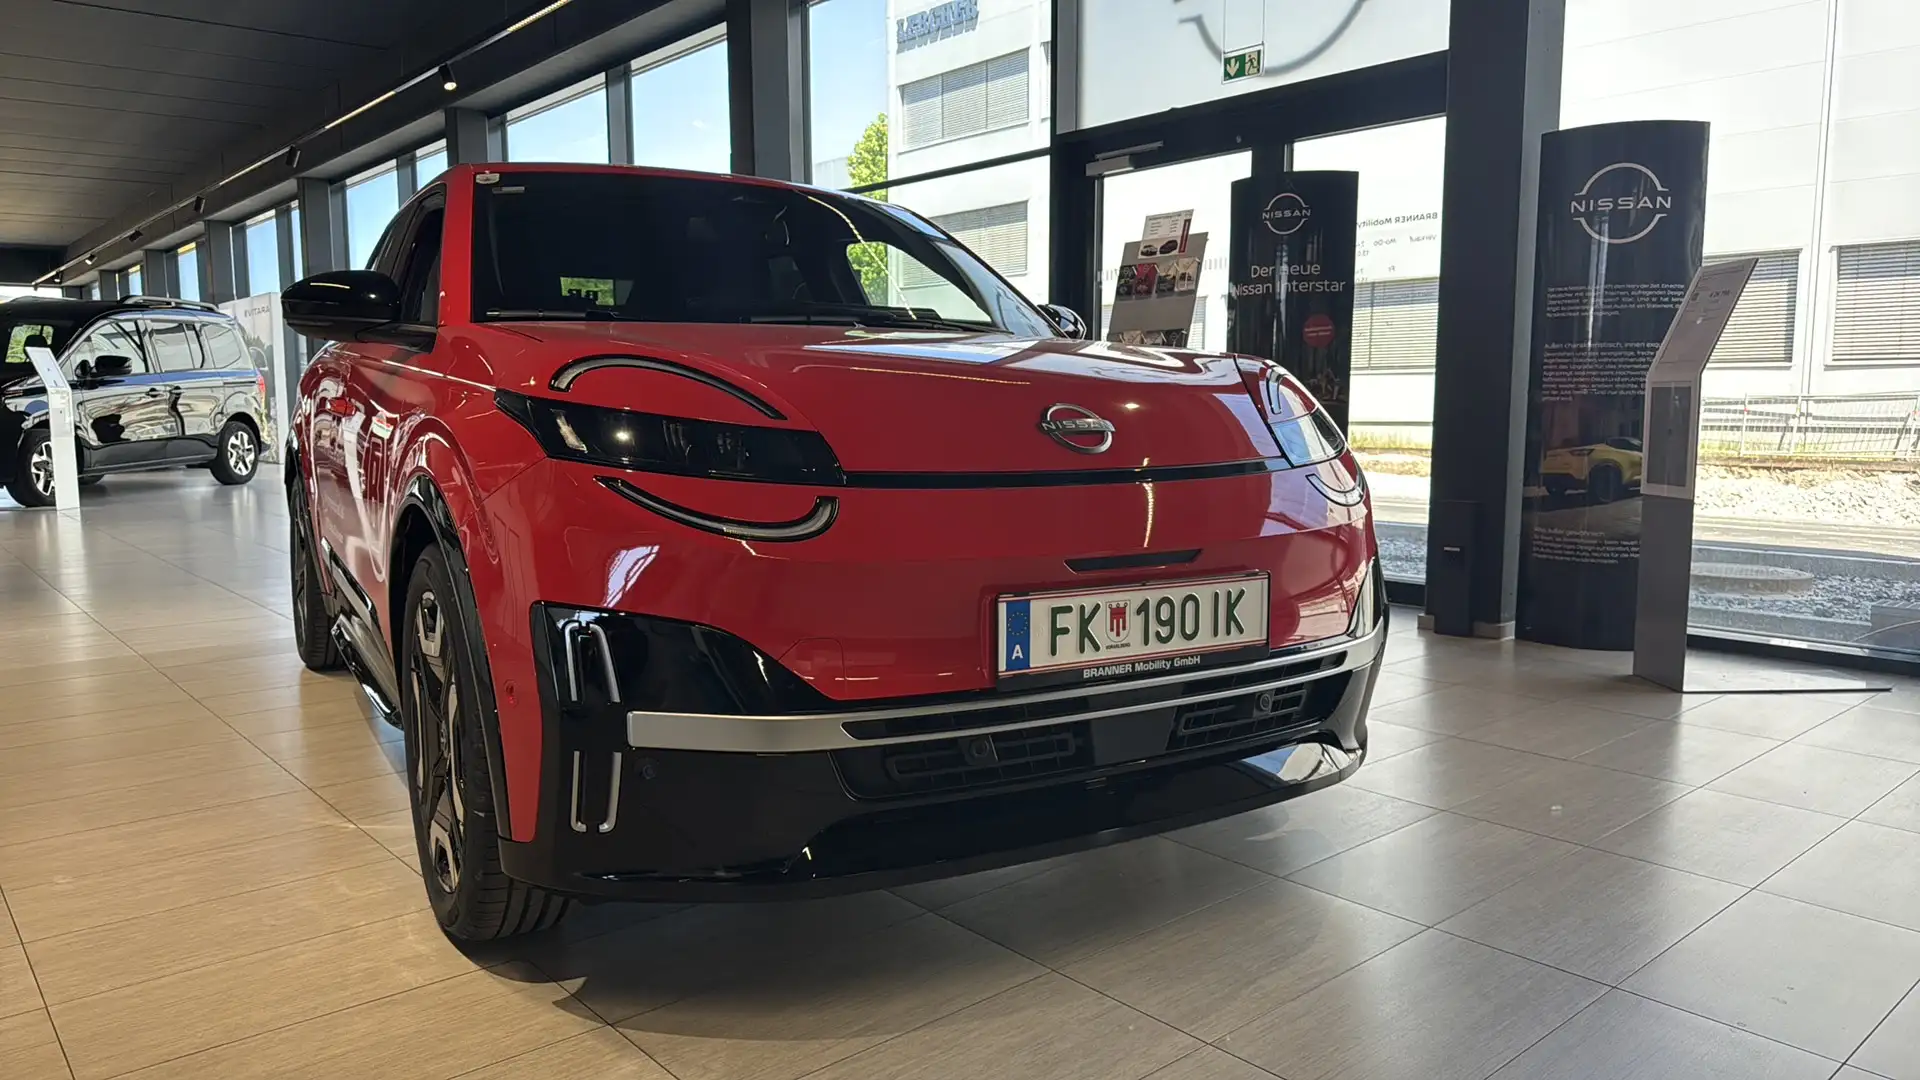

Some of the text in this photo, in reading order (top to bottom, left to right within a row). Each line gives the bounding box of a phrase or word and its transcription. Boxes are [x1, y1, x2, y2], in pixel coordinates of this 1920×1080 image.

[1571, 196, 1672, 213] NISSAN
[1262, 208, 1311, 221] NISSAN
[1251, 263, 1321, 278] Der neue
[1232, 279, 1346, 297] Nissan Interstar
[1041, 419, 1109, 431] NISSA
[1050, 586, 1246, 657] FK 190 IK
[1011, 644, 1025, 661] A
[1083, 656, 1201, 679] BRANNER Mobility GmbH
